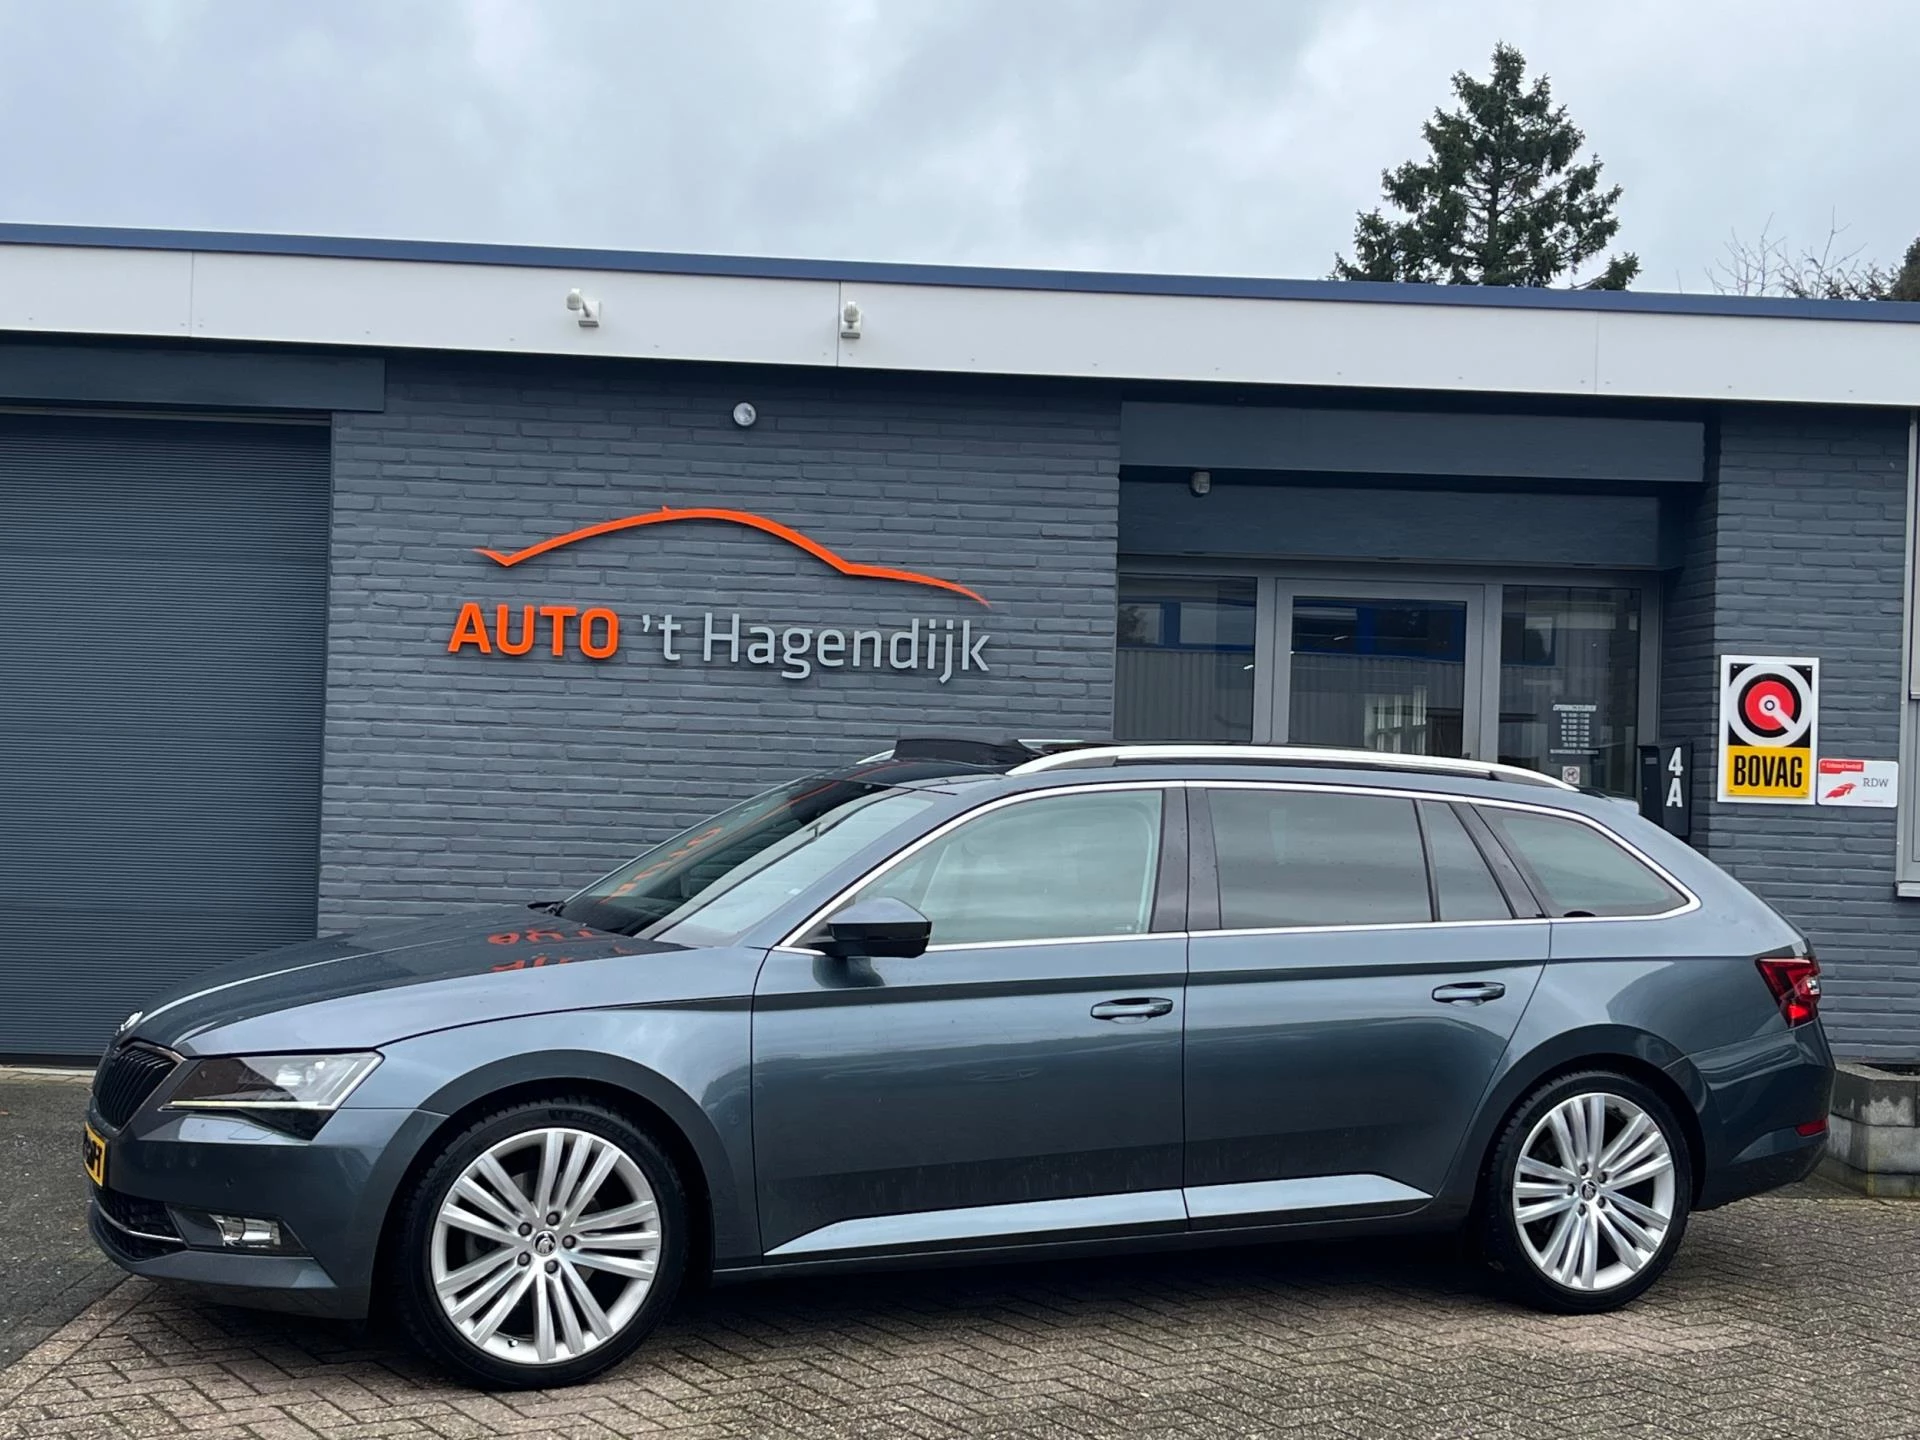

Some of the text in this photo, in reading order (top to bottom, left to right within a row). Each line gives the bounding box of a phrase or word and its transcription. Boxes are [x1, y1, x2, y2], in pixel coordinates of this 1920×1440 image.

[447, 602, 620, 660] AUTO
[703, 612, 991, 684] Hagendijk
[1668, 746, 1684, 776] 4
[1733, 754, 1803, 788] BOVAG
[1665, 777, 1683, 807] A
[1863, 777, 1889, 788] RDW
